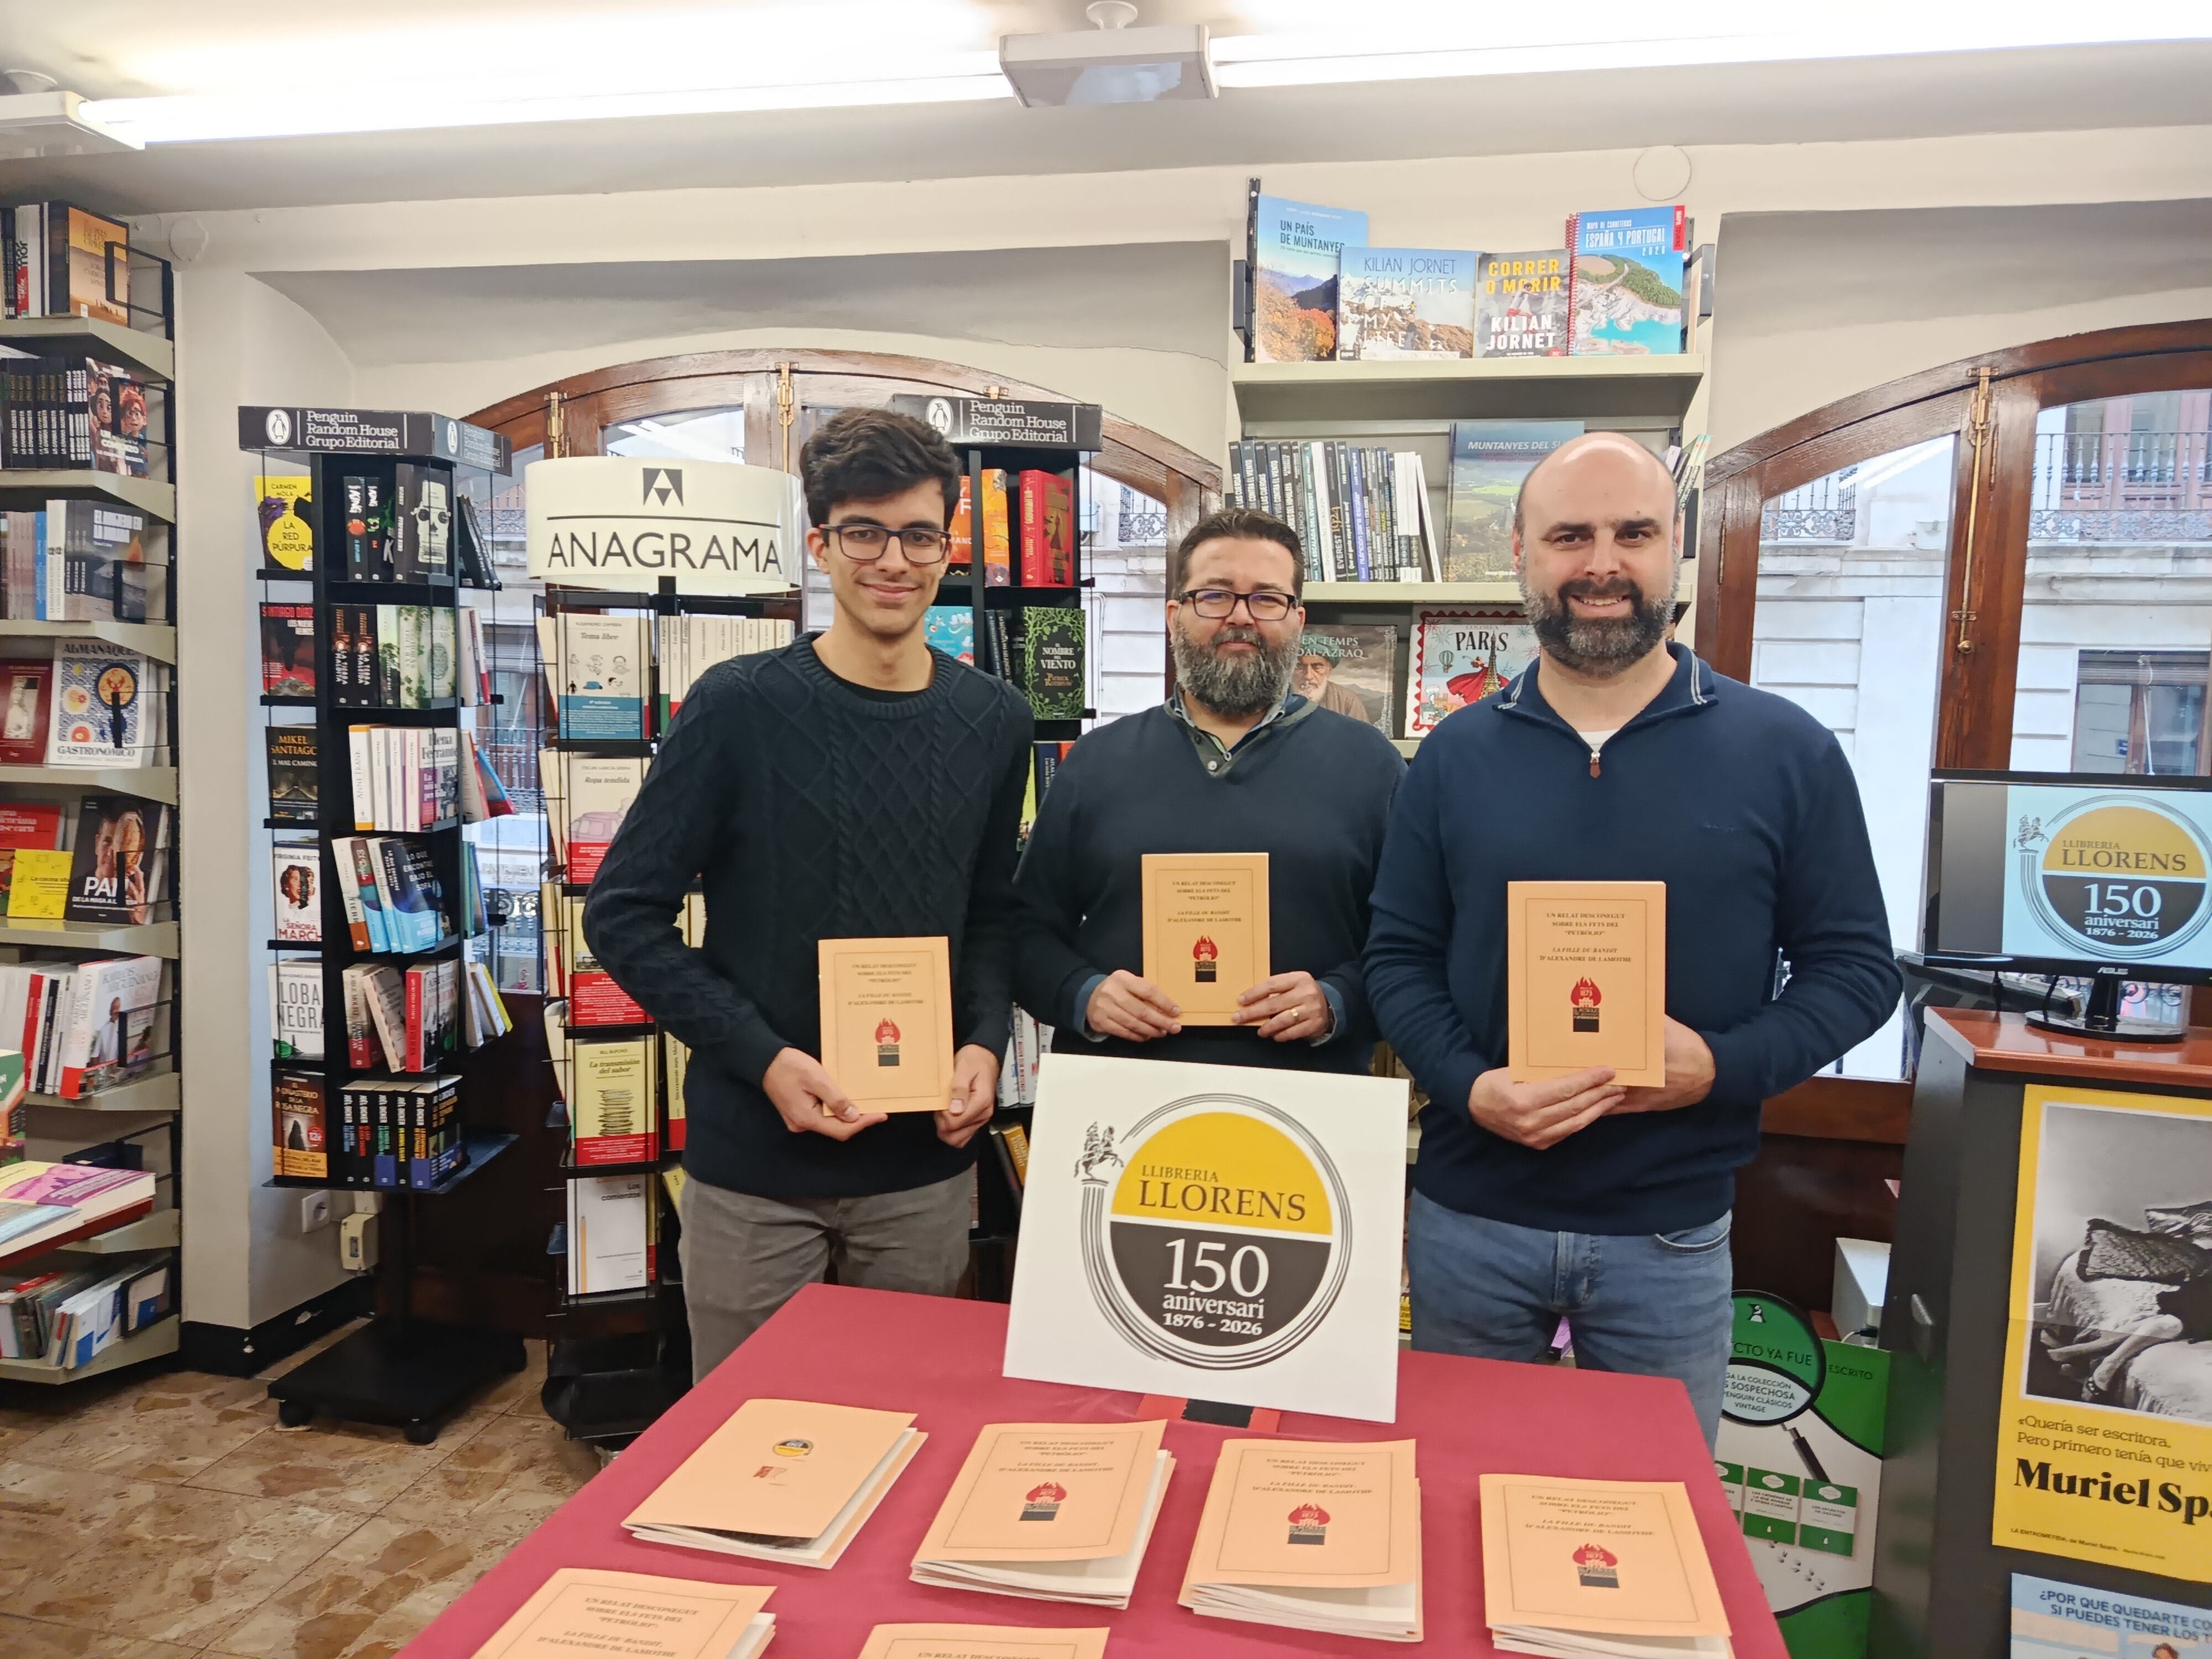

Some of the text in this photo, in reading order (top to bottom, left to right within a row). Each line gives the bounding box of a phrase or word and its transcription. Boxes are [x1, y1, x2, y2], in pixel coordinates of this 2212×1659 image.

[1281, 220, 1314, 236] UN PAÍS
[1281, 233, 1291, 244] DE
[1586, 228, 1665, 248] ESPAÑA Y PORTUGAL
[1364, 257, 1456, 275] KILIAN JORNET
[1488, 258, 1559, 277] CORRER
[1364, 276, 1457, 294] SUMMITS
[1486, 276, 1561, 295] O MORIR
[1364, 295, 1386, 310] OF
[1364, 313, 1391, 328] MY
[1491, 315, 1552, 332] KILIAN
[1364, 331, 1405, 347] LIFE
[1486, 332, 1556, 350] JORNET
[970, 400, 1025, 415] Penguin
[306, 411, 358, 426] Penguin
[970, 413, 1067, 429] Random House
[306, 423, 399, 436] Random House
[969, 427, 1067, 443] Grupo Editorial
[306, 435, 399, 449] Grupo Editorial
[1468, 441, 1529, 451] MUNTANYES
[283, 521, 296, 530] LA
[282, 531, 300, 540] RED
[272, 540, 312, 552] PÚRPURA
[547, 531, 782, 575] ANAGRAMA
[1334, 535, 1344, 569] EVEREST
[1357, 536, 1365, 565] nutrición
[1302, 635, 1358, 646] EN TEMPS
[1455, 631, 1509, 651] PARIS
[1042, 646, 1075, 656] NOMBRE
[1041, 659, 1076, 669] VIENTO
[279, 735, 308, 744] MIKEL
[2063, 839, 2120, 850] LLIBRERIA
[2062, 848, 2187, 871] LLORENS
[2084, 883, 2162, 917] 150
[286, 921, 317, 930] SEÑORA
[2084, 914, 2159, 930] aniversari
[2085, 927, 2115, 937] 1876
[2127, 929, 2158, 939] 2026
[2097, 967, 2128, 975] ASUS
[280, 982, 320, 1005] LOBA
[1141, 1164, 1219, 1183] LLIBRERIA
[601, 1192, 641, 1201] comienzos
[1139, 1179, 1306, 1222] LLORENS
[1163, 1238, 1269, 1298] 150
[1162, 1291, 1265, 1320] aniversari
[1162, 1313, 1204, 1329] 1876
[1219, 1318, 1262, 1335] 2026
[1767, 1348, 1783, 1360] YA
[1787, 1352, 1812, 1366] FUE
[1829, 1364, 1874, 1380] ESCRITO
[1731, 1381, 1795, 1400] SOSPECHOSA
[1747, 1376, 1791, 1389] COLECCIÓN
[1735, 1401, 1766, 1413] VINTAGE
[1756, 1396, 1792, 1408] CLÁSICOS
[2018, 1415, 2171, 1449] «Quería ser escritora.
[2017, 1432, 2212, 1472] Pero primero tenía que viv
[2014, 1458, 2212, 1526] Muriel Sp
[2039, 1590, 2075, 1605] ¿POR
[2112, 1603, 2189, 1626] QUEDARTE
[2193, 1618, 2212, 1630] CO
[2051, 1604, 2062, 1615] SI
[2066, 1606, 2120, 1626] PUEDES
[2125, 1618, 2170, 1636] TENER
[2173, 1629, 2199, 1641] LOS
